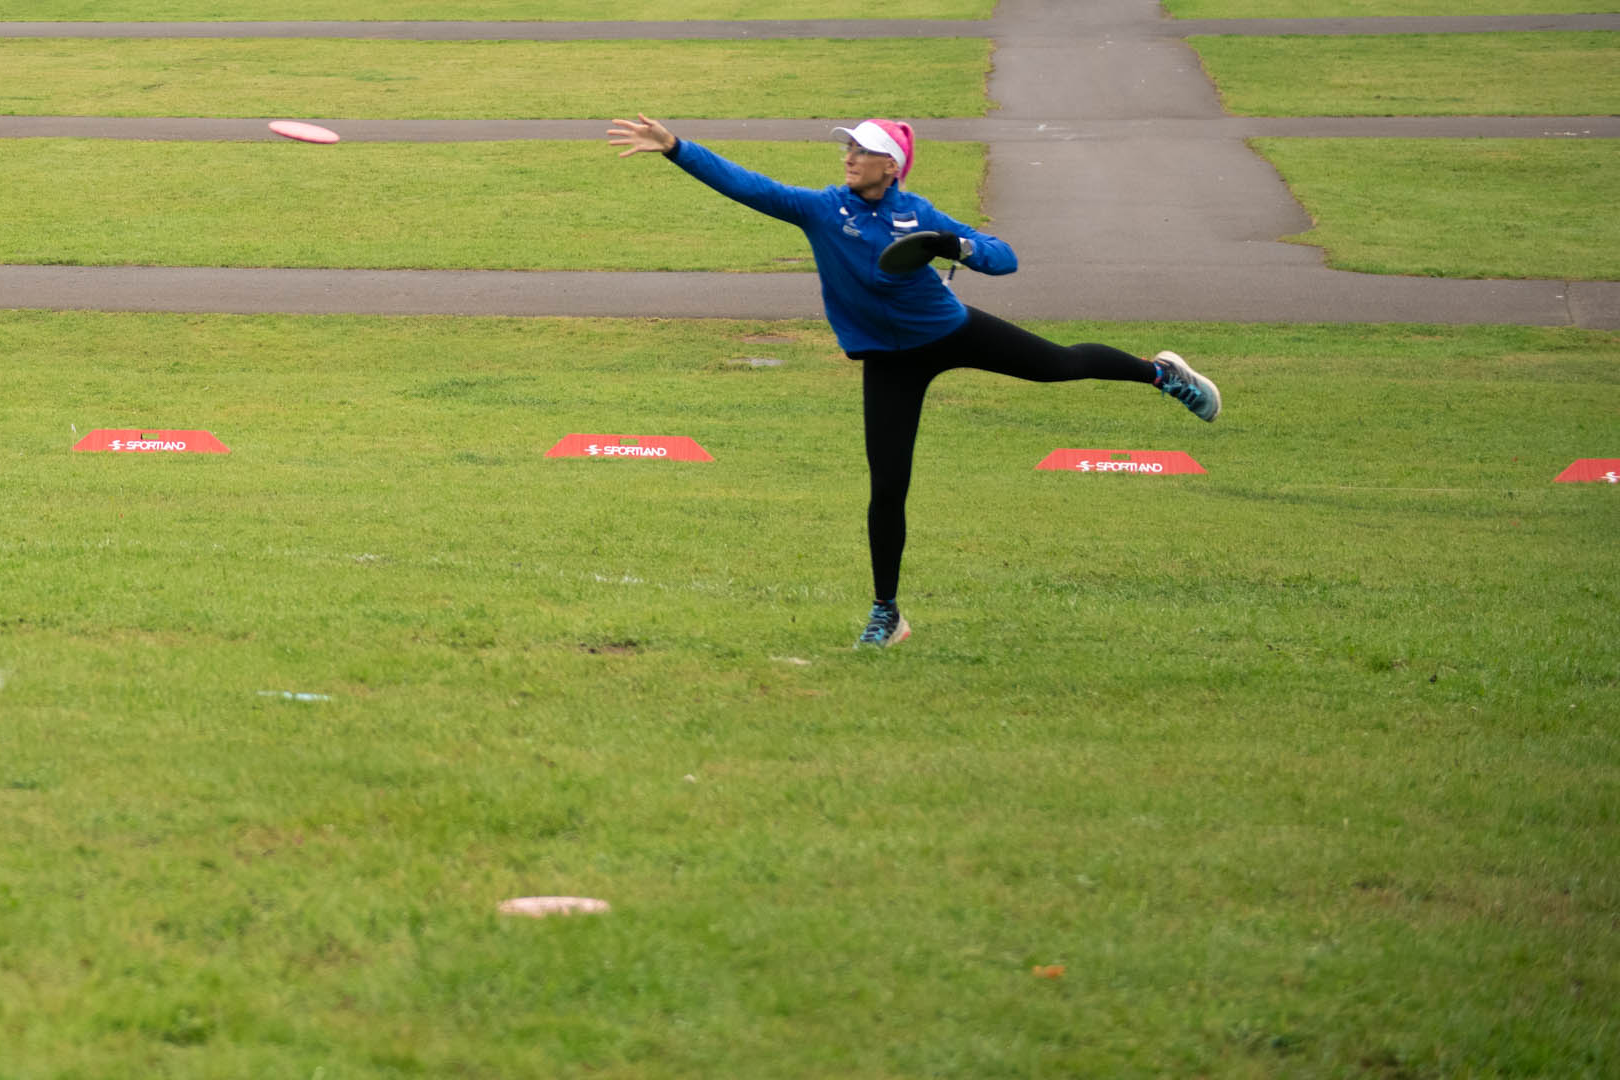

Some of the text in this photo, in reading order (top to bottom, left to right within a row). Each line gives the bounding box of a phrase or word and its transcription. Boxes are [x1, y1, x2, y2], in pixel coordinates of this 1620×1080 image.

[125, 440, 186, 451] SPORTLAND
[603, 445, 667, 456] SPORTLAND
[1095, 461, 1163, 473] SPORTLAND
